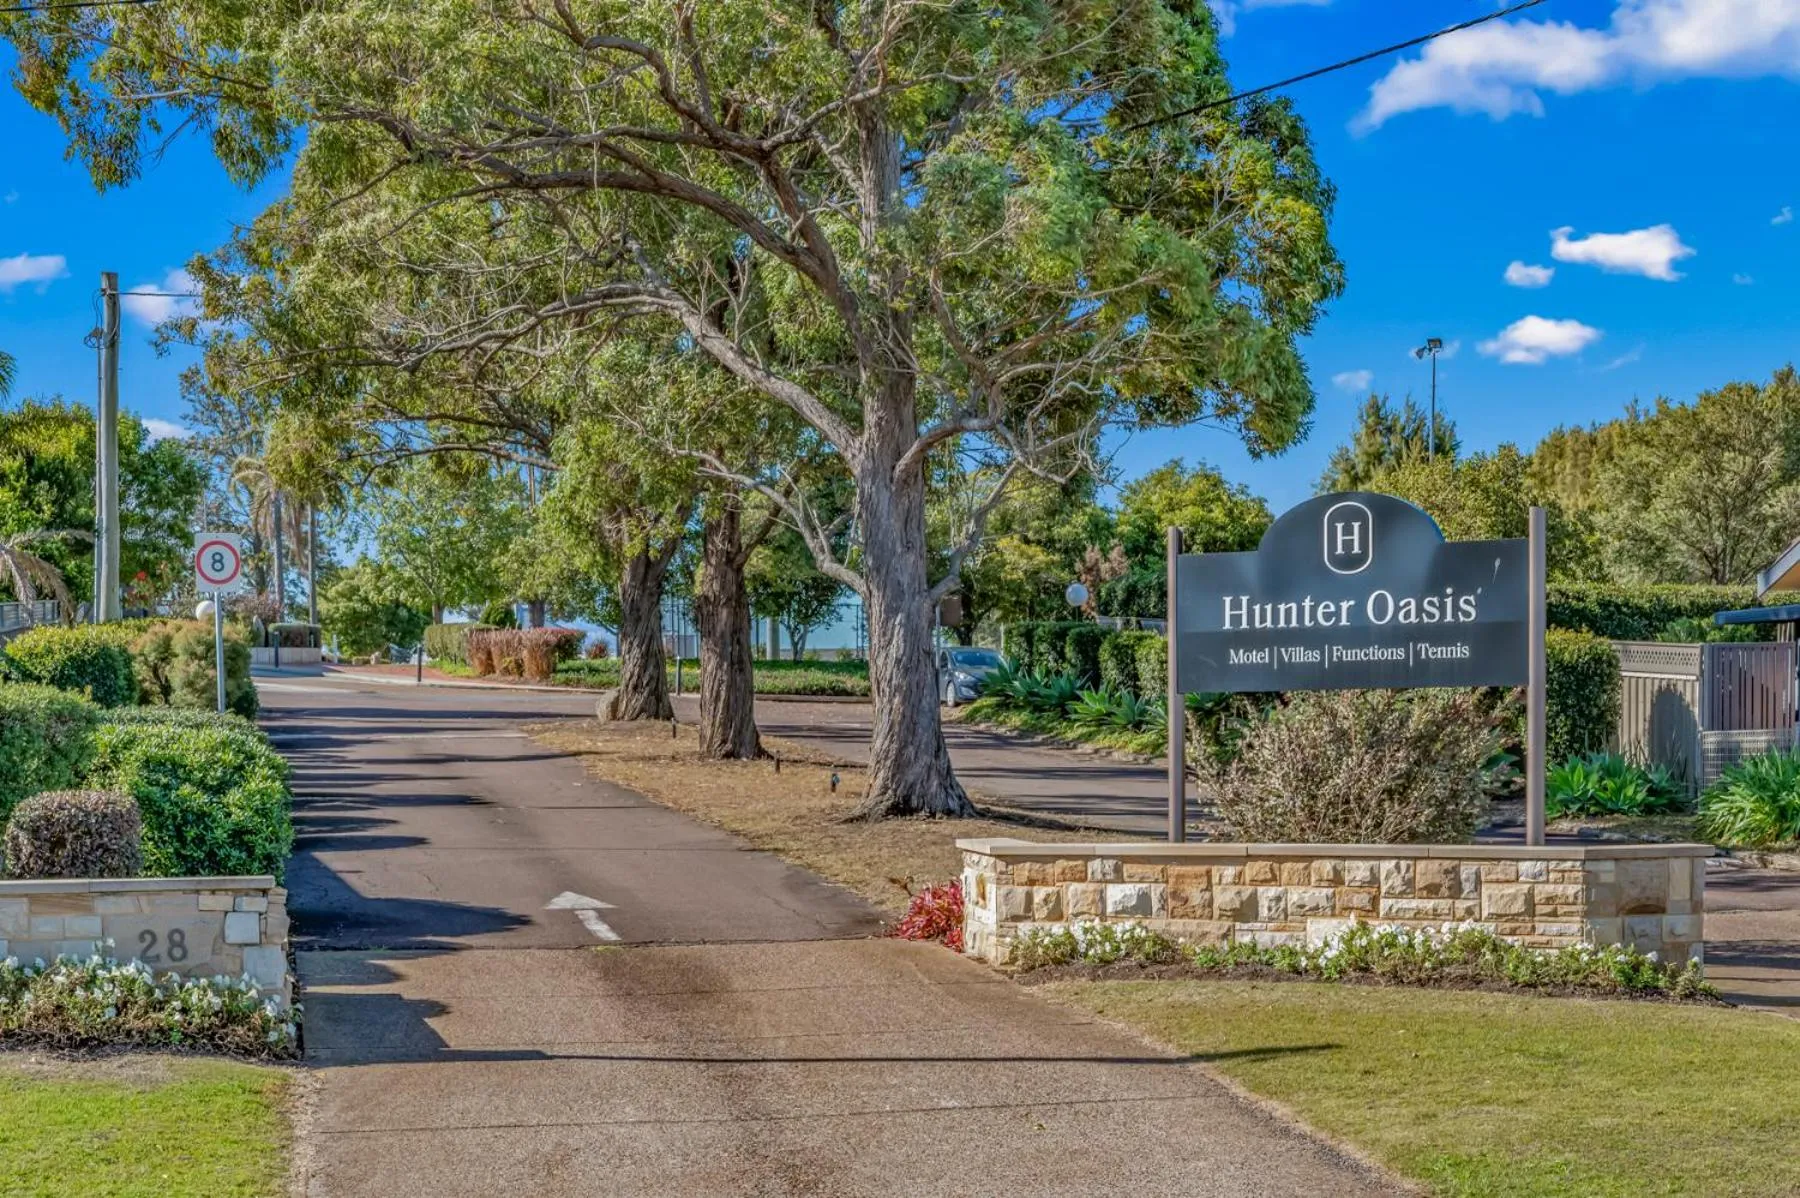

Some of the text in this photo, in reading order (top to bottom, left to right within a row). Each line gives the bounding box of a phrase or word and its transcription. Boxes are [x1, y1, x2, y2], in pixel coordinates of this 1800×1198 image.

[1334, 521, 1362, 555] H
[211, 551, 225, 573] 8
[1221, 587, 1478, 631] Hunter Oasis
[1228, 642, 1470, 665] Motel Villas Functions Tennis
[138, 927, 189, 963] 28
